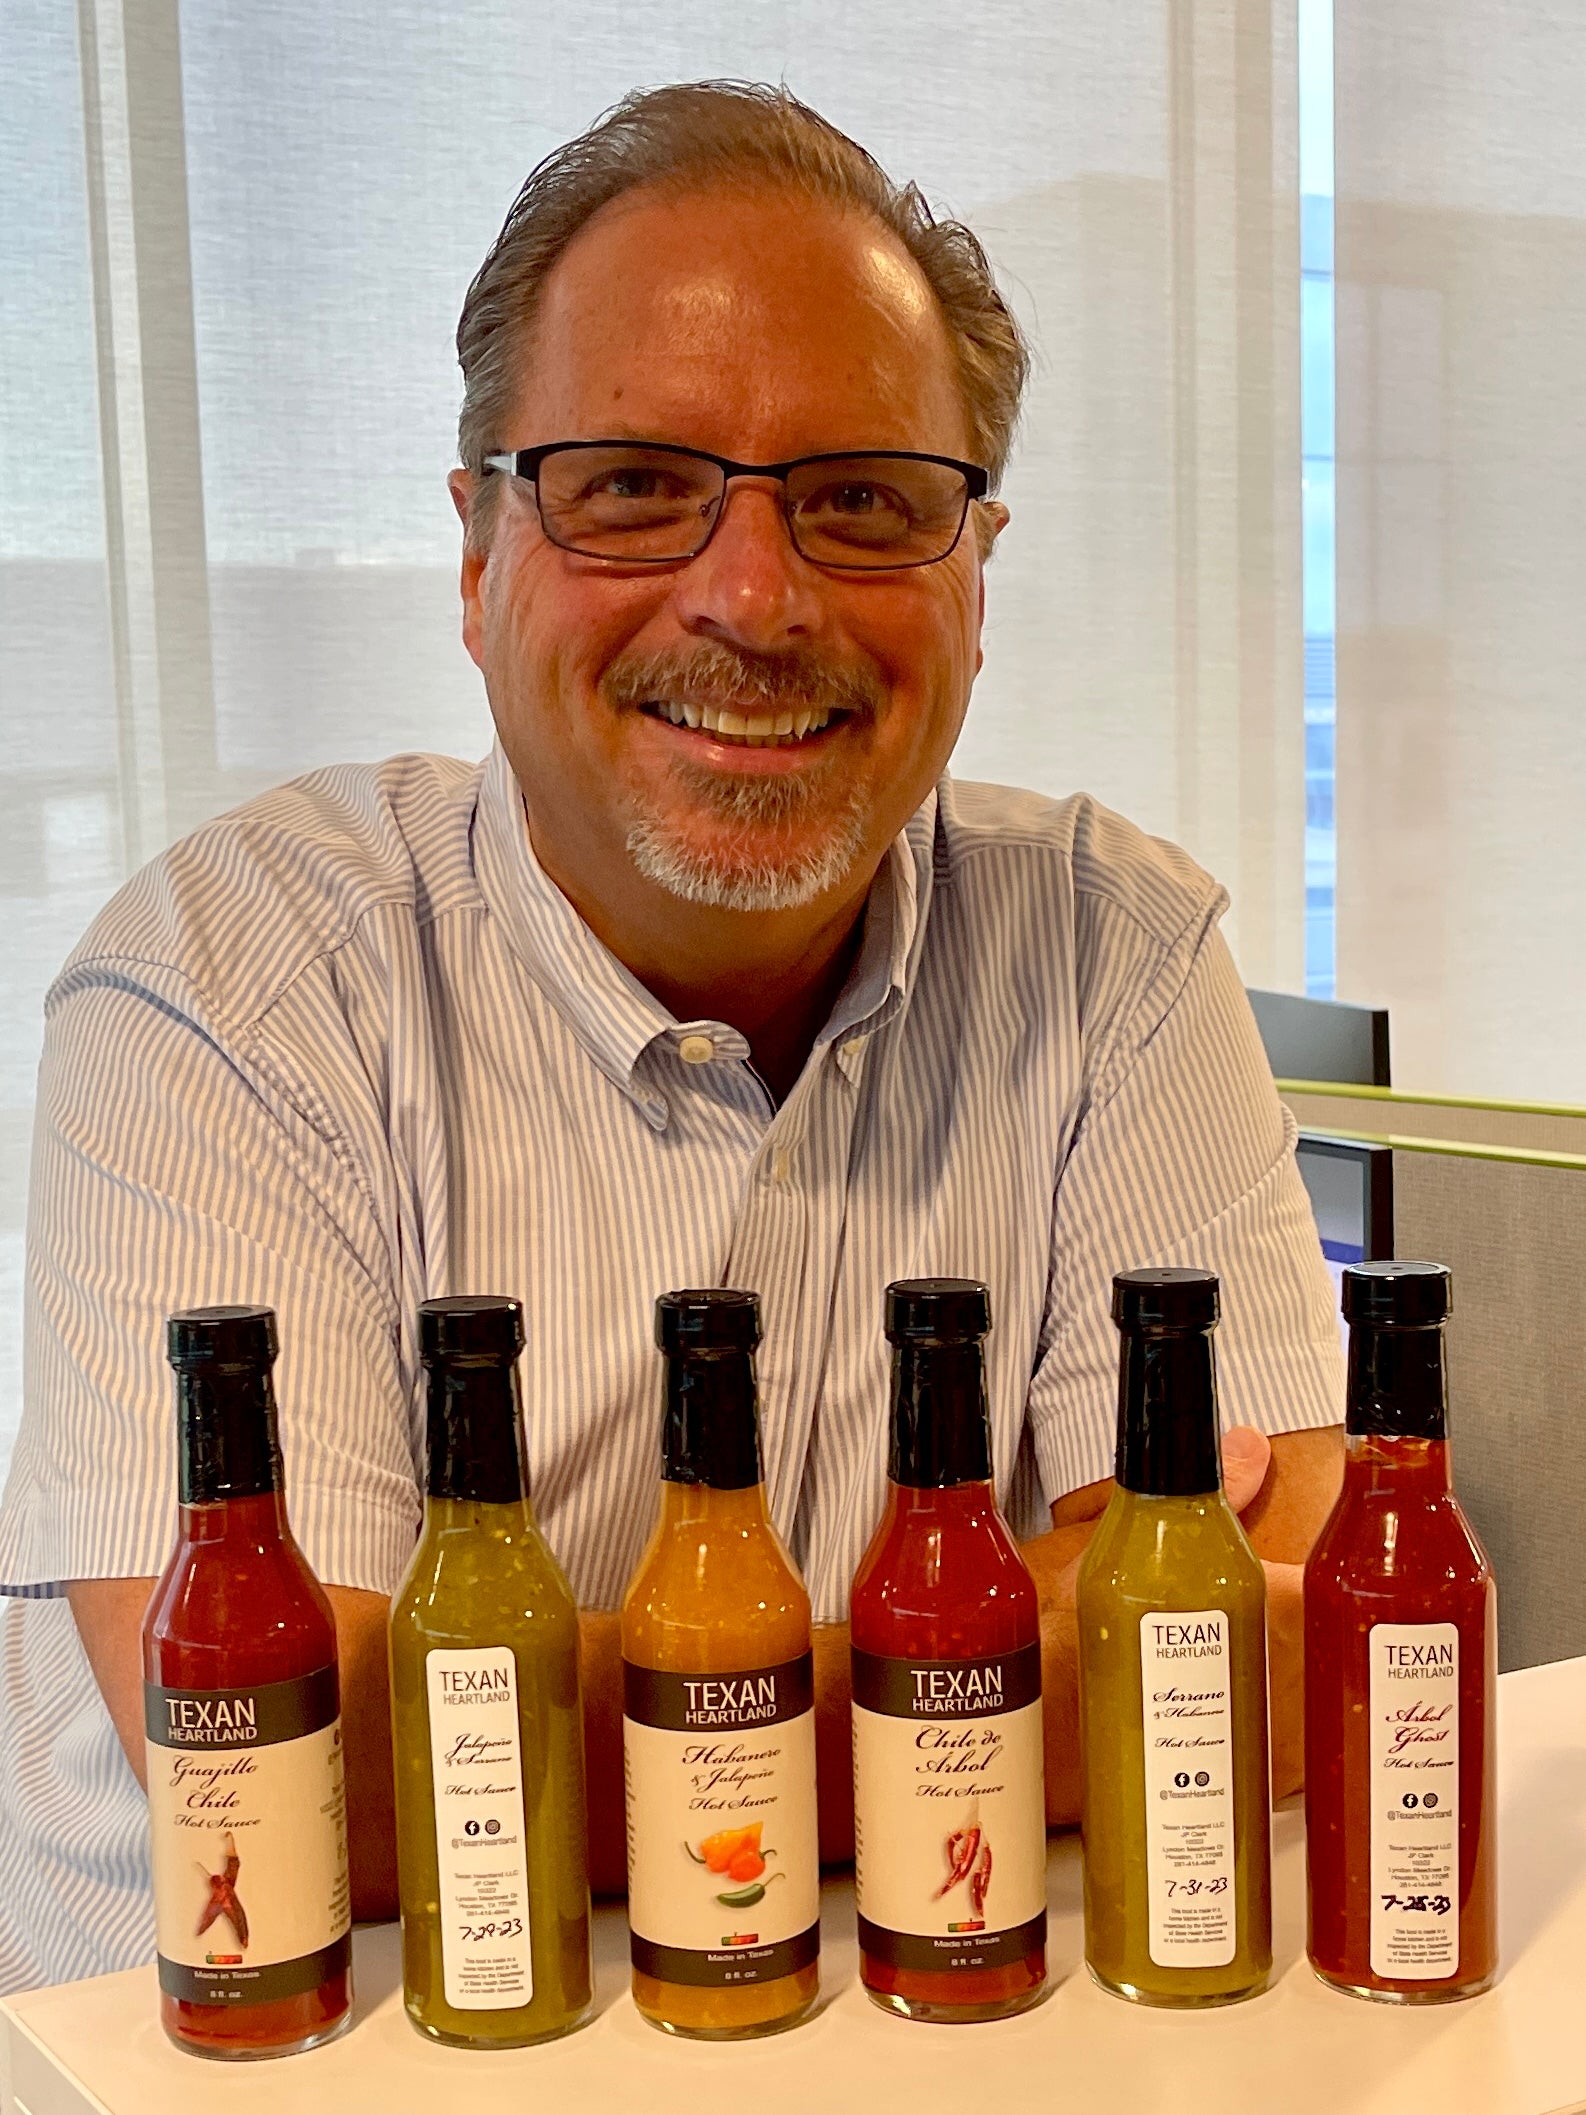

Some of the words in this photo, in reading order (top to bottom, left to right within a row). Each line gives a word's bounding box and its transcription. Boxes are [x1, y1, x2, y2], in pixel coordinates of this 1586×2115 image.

[1152, 1622, 1220, 1645] TEXAN
[1156, 1645, 1222, 1658] HEARTLAND
[1384, 1644, 1452, 1665] TEXAN
[439, 1668, 508, 1691] TEXAN
[1388, 1666, 1454, 1679] HEARTLAND
[911, 1665, 1002, 1698] TEXAN
[443, 1691, 510, 1705] HEARTLAND
[683, 1675, 776, 1710] TEXAN
[1153, 1687, 1224, 1703] Serrano
[912, 1693, 1003, 1712] HEARTLAND
[166, 1698, 255, 1728] TEXAN
[686, 1704, 777, 1724] HEARTLAND
[1386, 1701, 1453, 1722] Árbol
[169, 1727, 258, 1742] HEARTLAND
[915, 1725, 976, 1750] Chile
[981, 1730, 1002, 1746] de
[1155, 1738, 1184, 1747] Hot
[1185, 1736, 1224, 1747] Sauce
[1388, 1726, 1450, 1753] Ghost
[682, 1744, 781, 1764] Habanero
[915, 1745, 1003, 1773] Árbol
[1384, 1758, 1414, 1768] Hot
[1415, 1758, 1454, 1768] Sauce
[169, 1755, 259, 1789] Guajillo
[697, 1767, 775, 1793] Jalapeño
[187, 1787, 240, 1808] Chile
[445, 1784, 472, 1795] Hot
[474, 1784, 516, 1795] Sauce
[916, 1784, 951, 1797] Hot
[955, 1784, 1005, 1798] Sauce
[1160, 1788, 1224, 1800] @TexanHeartland
[689, 1796, 723, 1810] Hot
[728, 1795, 778, 1810] Sauce
[174, 1814, 204, 1828] Hot
[207, 1816, 261, 1829] Sauce
[1387, 1810, 1452, 1821] @TexanHeartland
[452, 1835, 517, 1849] @TexanHeartland
[1165, 1877, 1228, 1897] 7-31-23
[975, 1937, 1000, 1945] Texas
[747, 1949, 774, 1958] Texas
[194, 1971, 218, 1979] Made
